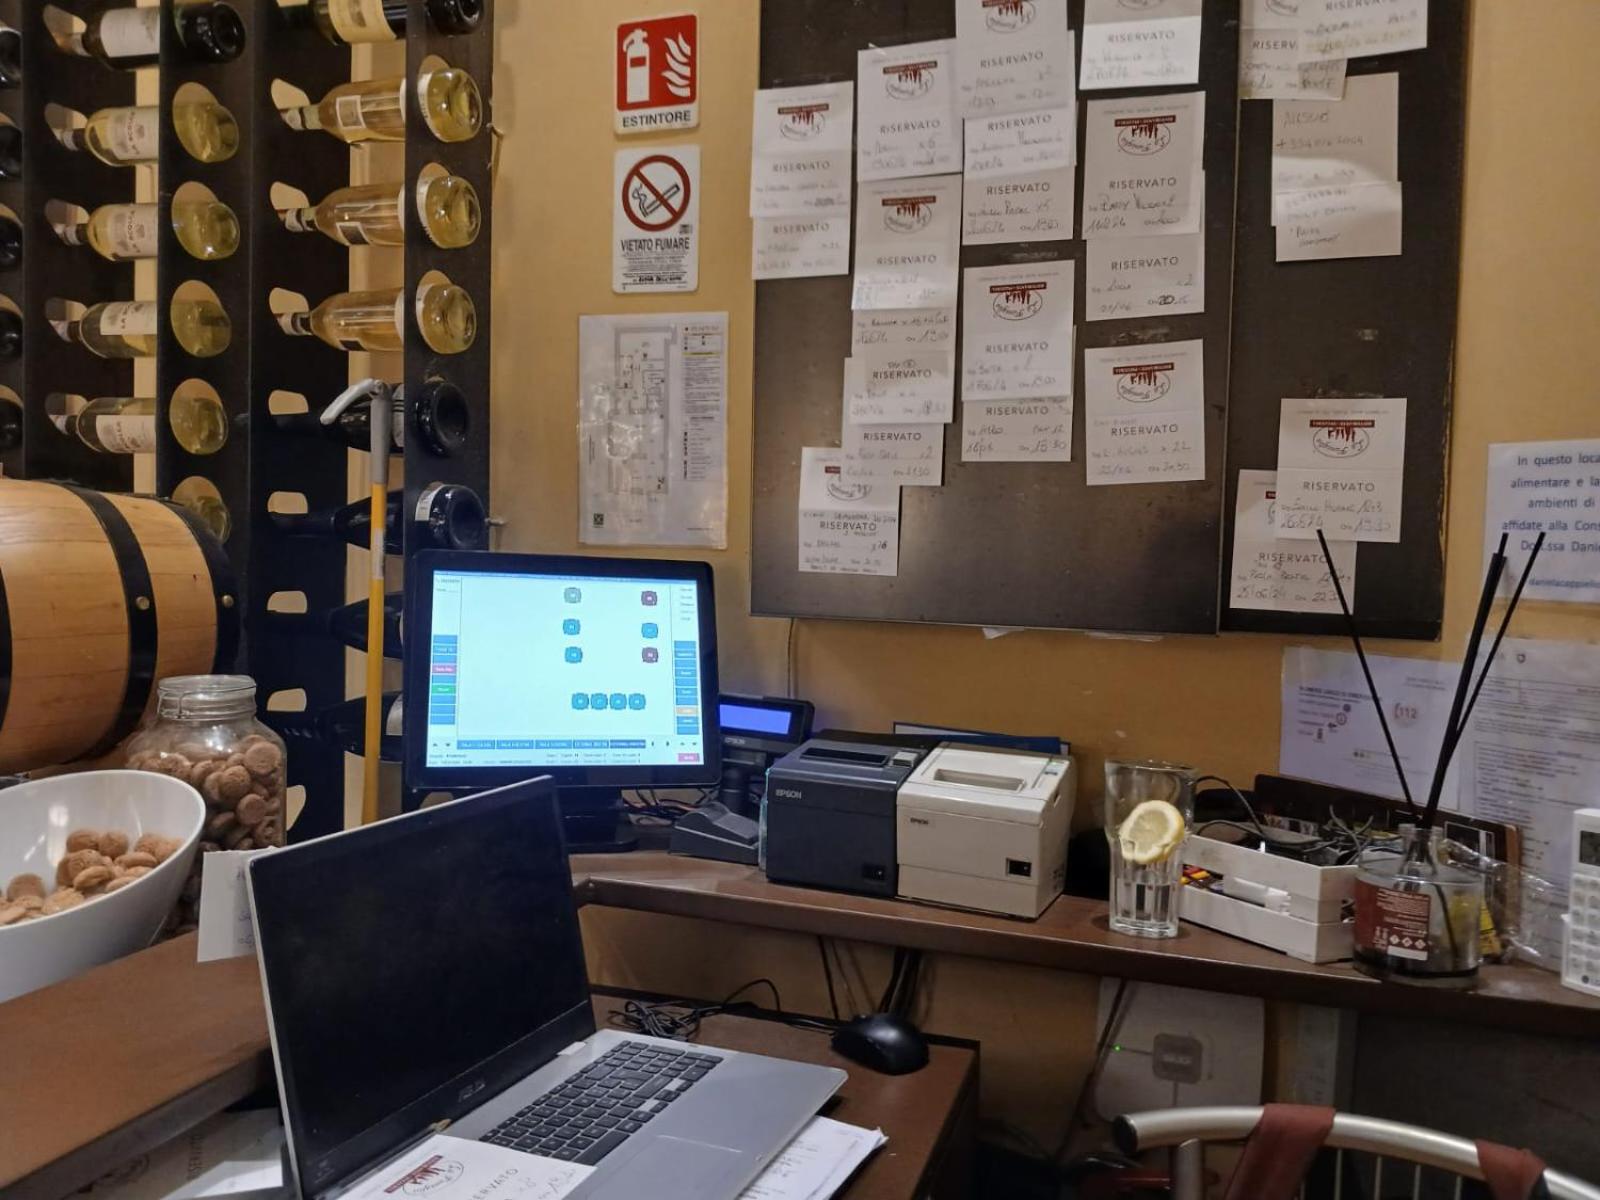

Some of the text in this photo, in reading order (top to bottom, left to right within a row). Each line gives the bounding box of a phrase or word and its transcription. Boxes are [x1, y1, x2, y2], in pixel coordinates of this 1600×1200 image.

[1108, 30, 1176, 43] RISERVATO
[1252, 40, 1298, 50] RISERV
[980, 51, 1044, 68] RISERVATO
[622, 110, 691, 128] ESTINTORE
[987, 114, 1052, 130] RISERVATO
[880, 119, 941, 134] RISERVATO
[772, 160, 831, 173] RISERVATO
[986, 181, 1050, 196] RISERVATO
[1109, 176, 1177, 190] RISERVATO
[772, 222, 830, 235] RISERVATO
[621, 237, 690, 252] VIETATO FUMARE
[876, 254, 937, 266] RISERVATO
[1111, 256, 1179, 271] RISERVATO
[986, 341, 1049, 353] RISERVATO
[872, 368, 932, 380] RISERVATO
[986, 405, 1049, 416] RISERVATO
[1111, 423, 1179, 437] RISERVATO
[863, 432, 922, 441] RISERVATO
[1517, 456, 1528, 466] In
[1534, 454, 1572, 467] questo
[1303, 480, 1375, 491] RISERVATO
[1510, 477, 1570, 489] alimentare
[1528, 498, 1595, 509] ambienti di
[820, 521, 877, 531] RISERVATO
[1502, 520, 1543, 531] affidate
[1548, 520, 1568, 531] alla
[1520, 540, 1565, 552] Do.ssa
[775, 789, 802, 799] EPSON
[910, 817, 929, 825] EPSON
